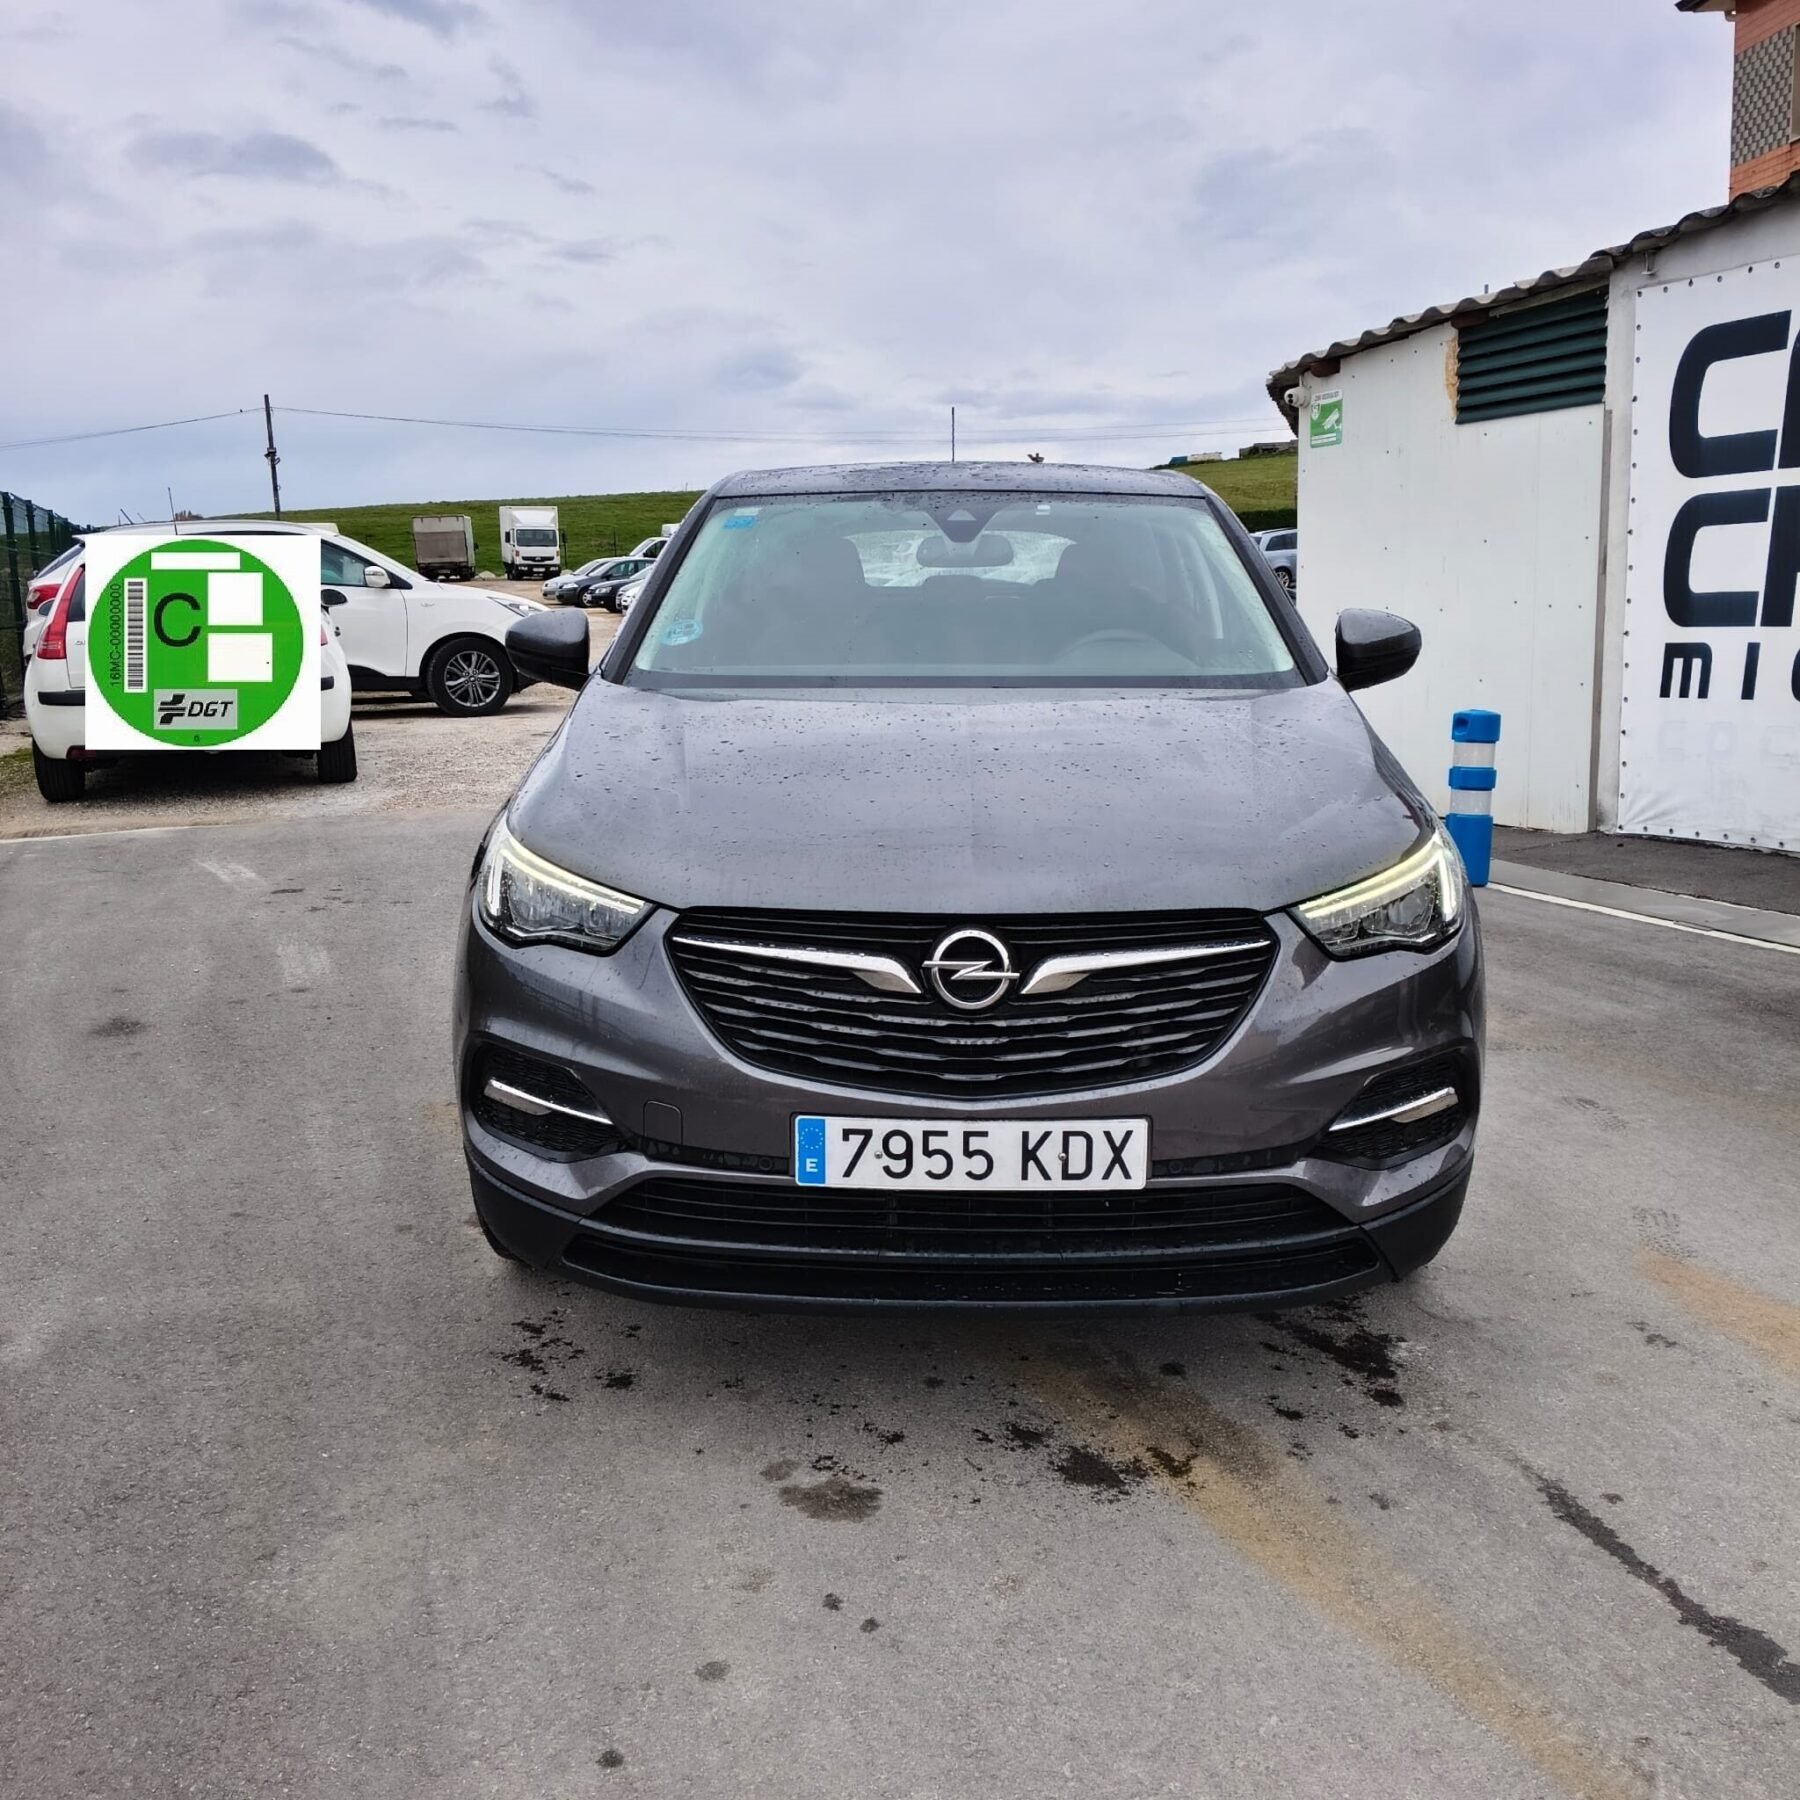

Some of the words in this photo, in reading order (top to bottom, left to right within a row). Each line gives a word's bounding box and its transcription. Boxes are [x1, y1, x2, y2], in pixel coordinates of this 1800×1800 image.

[1669, 309, 1800, 478] C
[1659, 642, 1800, 702] MI
[806, 1158, 818, 1172] E
[841, 1129, 994, 1181] 7955
[1021, 1130, 1134, 1181] KDX
